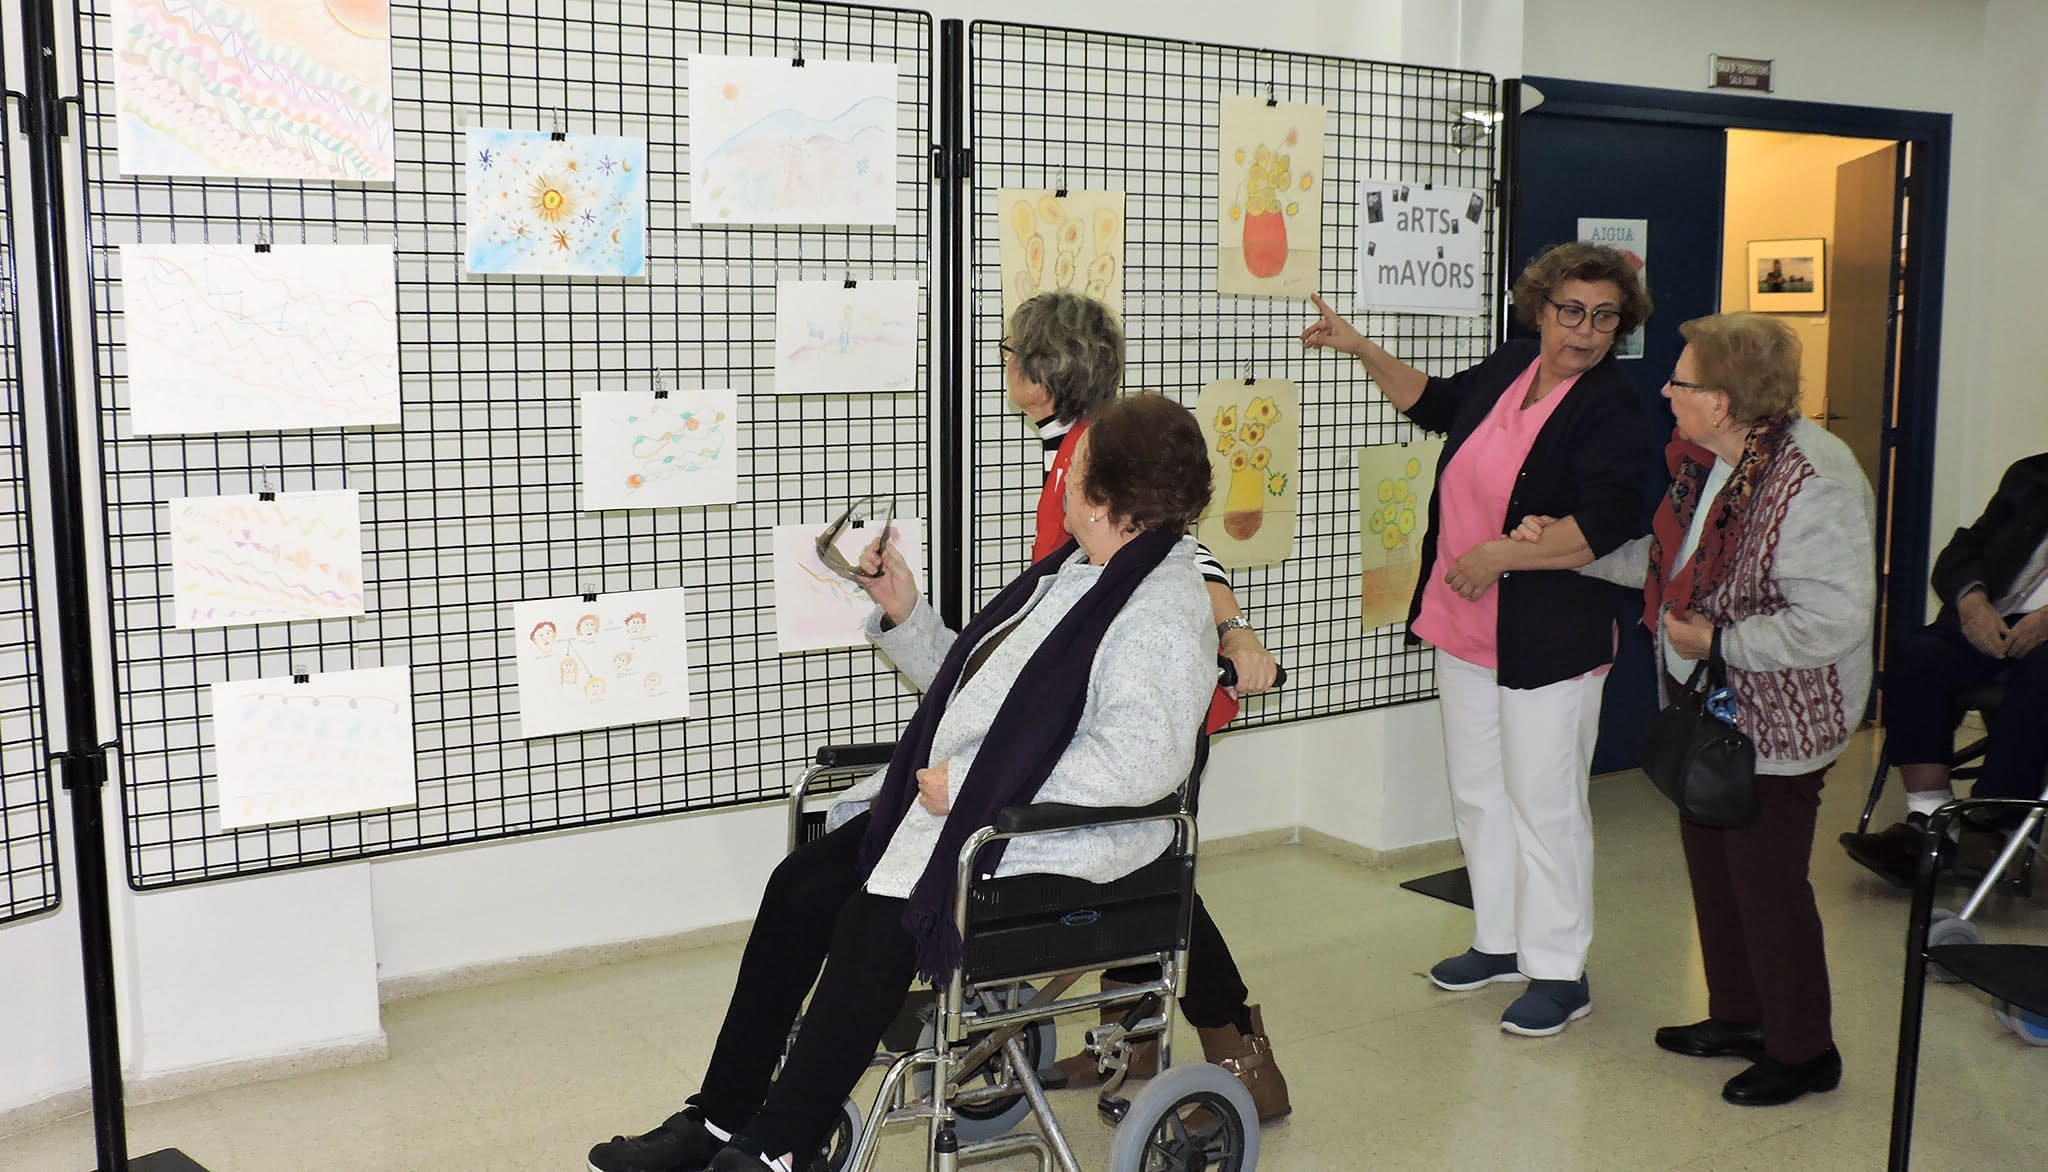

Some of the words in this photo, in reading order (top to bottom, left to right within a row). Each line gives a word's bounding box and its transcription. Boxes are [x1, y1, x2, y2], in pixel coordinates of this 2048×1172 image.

[1397, 206, 1450, 234] aRTS
[1591, 227, 1634, 242] AIGUA
[1378, 259, 1474, 289] mAYORS
